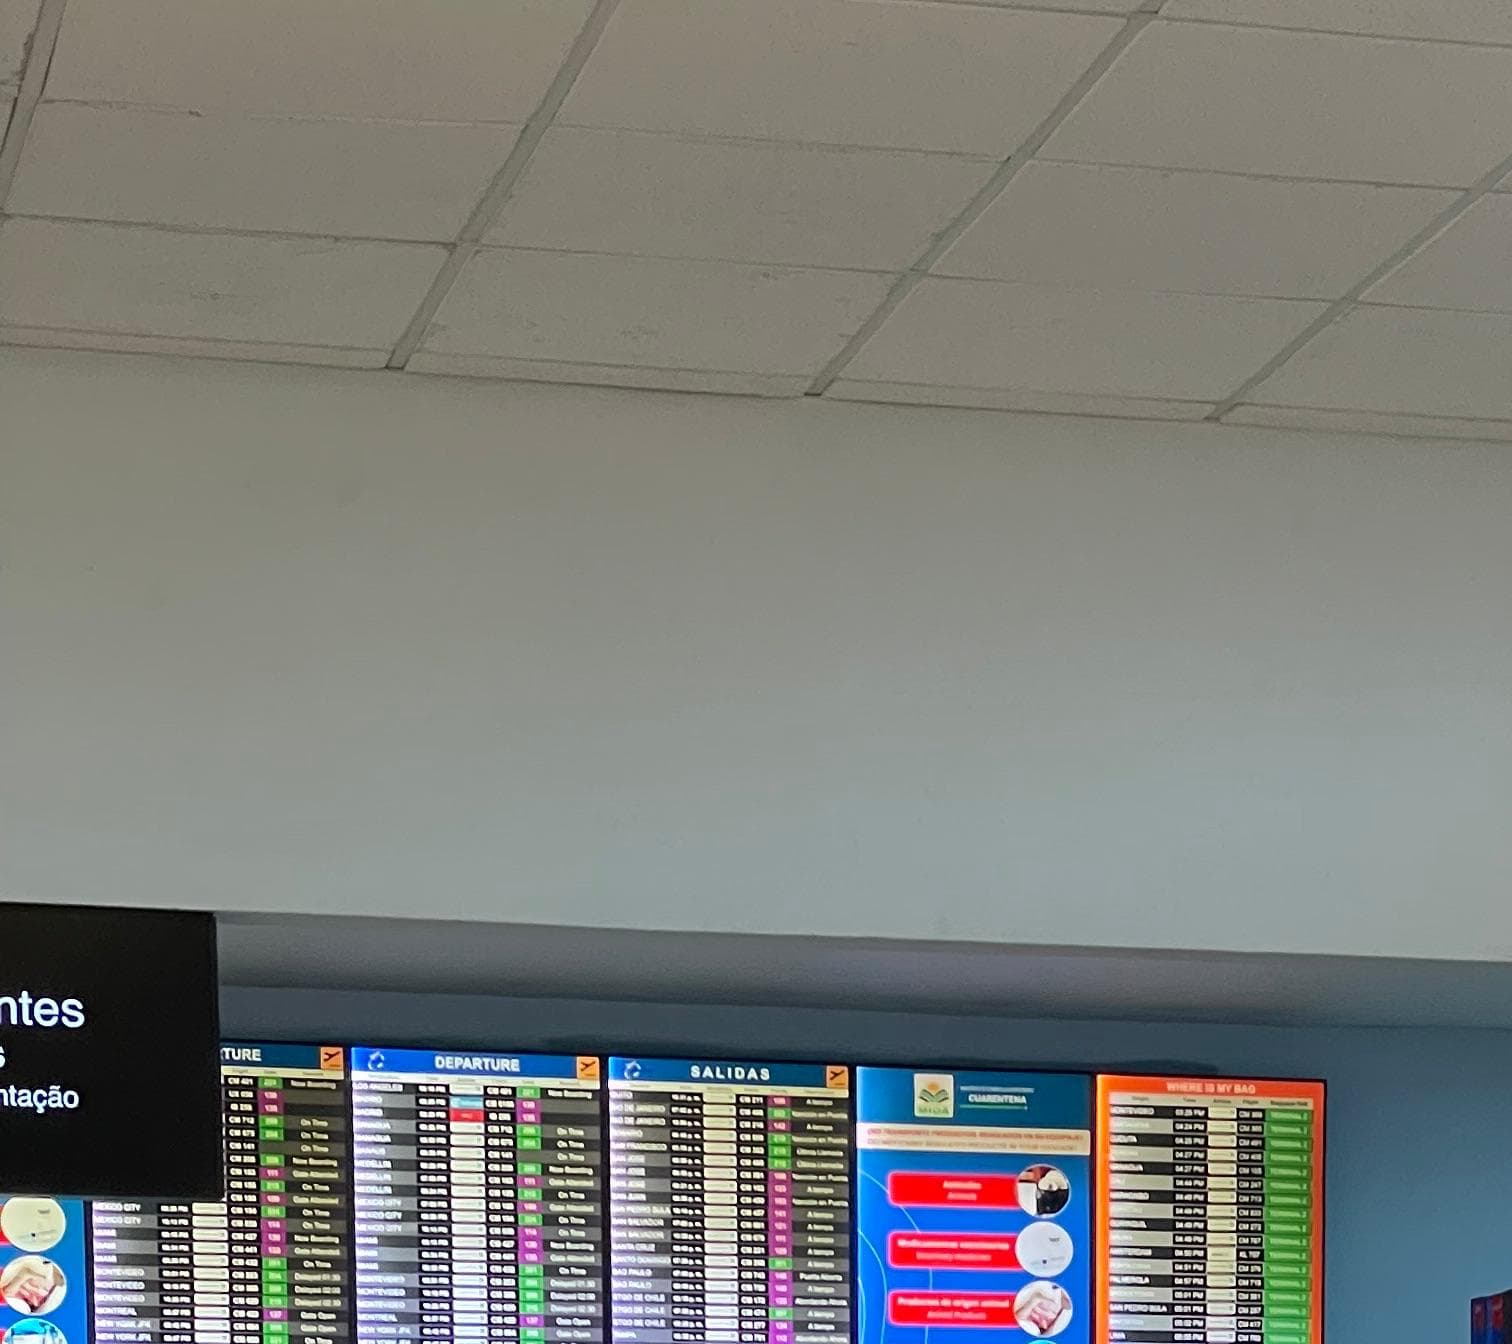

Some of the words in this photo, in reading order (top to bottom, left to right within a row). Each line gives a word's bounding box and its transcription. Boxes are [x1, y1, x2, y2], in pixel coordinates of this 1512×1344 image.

[221, 1048, 262, 1062] TURE
[435, 1056, 520, 1072] DEPARTURE
[690, 1065, 770, 1080] SALIDAS
[1166, 1082, 1203, 1093] WHERE
[1205, 1083, 1214, 1093] IS
[1217, 1083, 1232, 1093] MY
[1234, 1084, 1256, 1094] BAG
